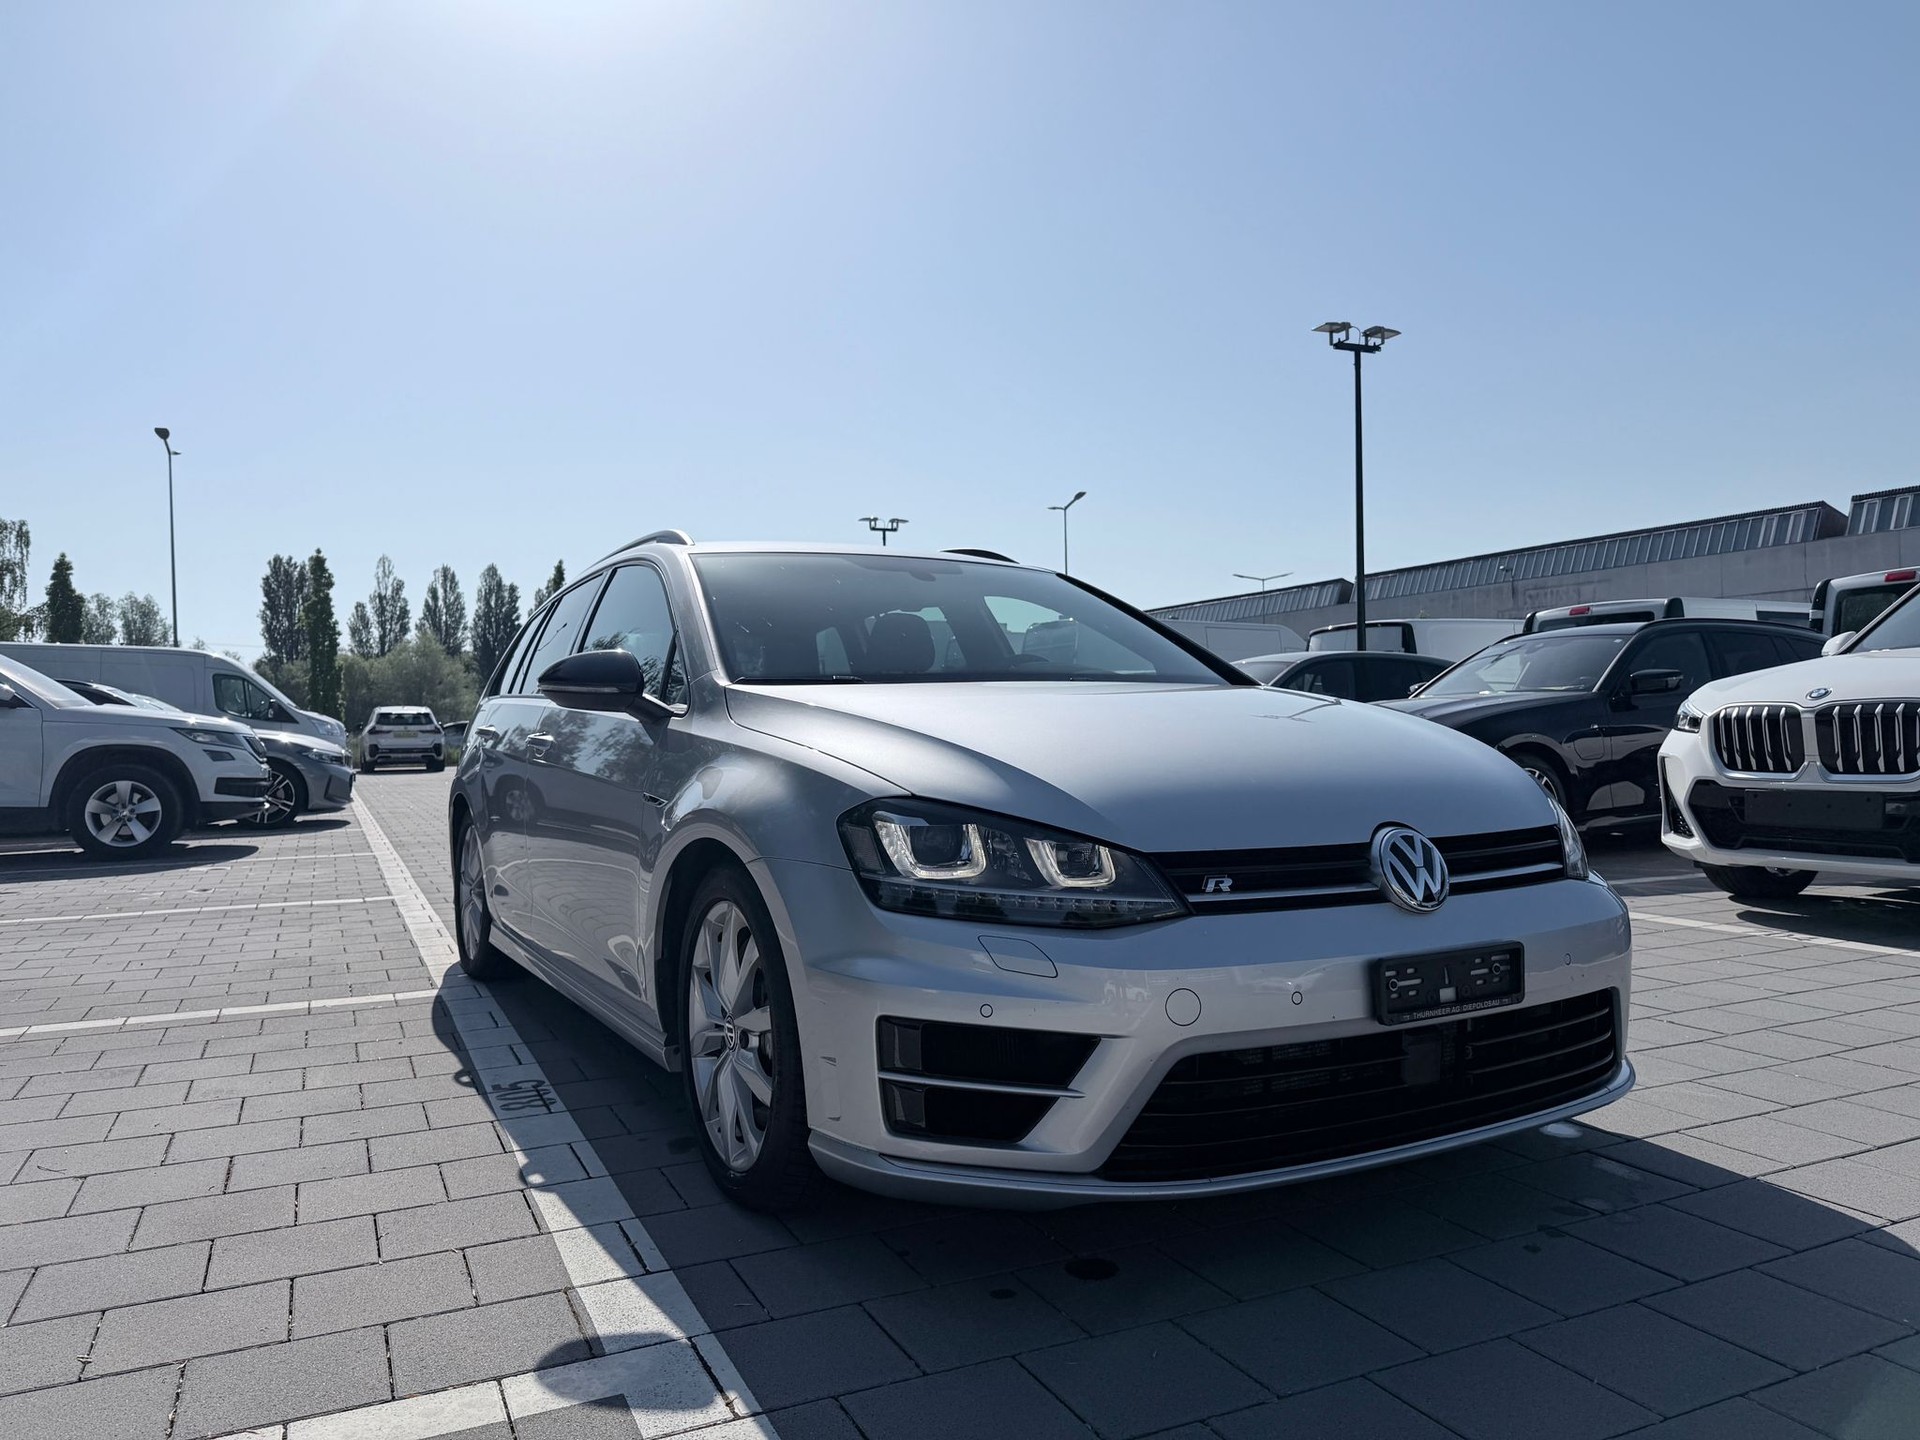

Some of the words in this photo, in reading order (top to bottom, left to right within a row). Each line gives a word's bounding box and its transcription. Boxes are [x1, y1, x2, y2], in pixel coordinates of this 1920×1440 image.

[1382, 829, 1448, 909] VW
[1205, 877, 1233, 893] R
[491, 1080, 557, 1111] 805
